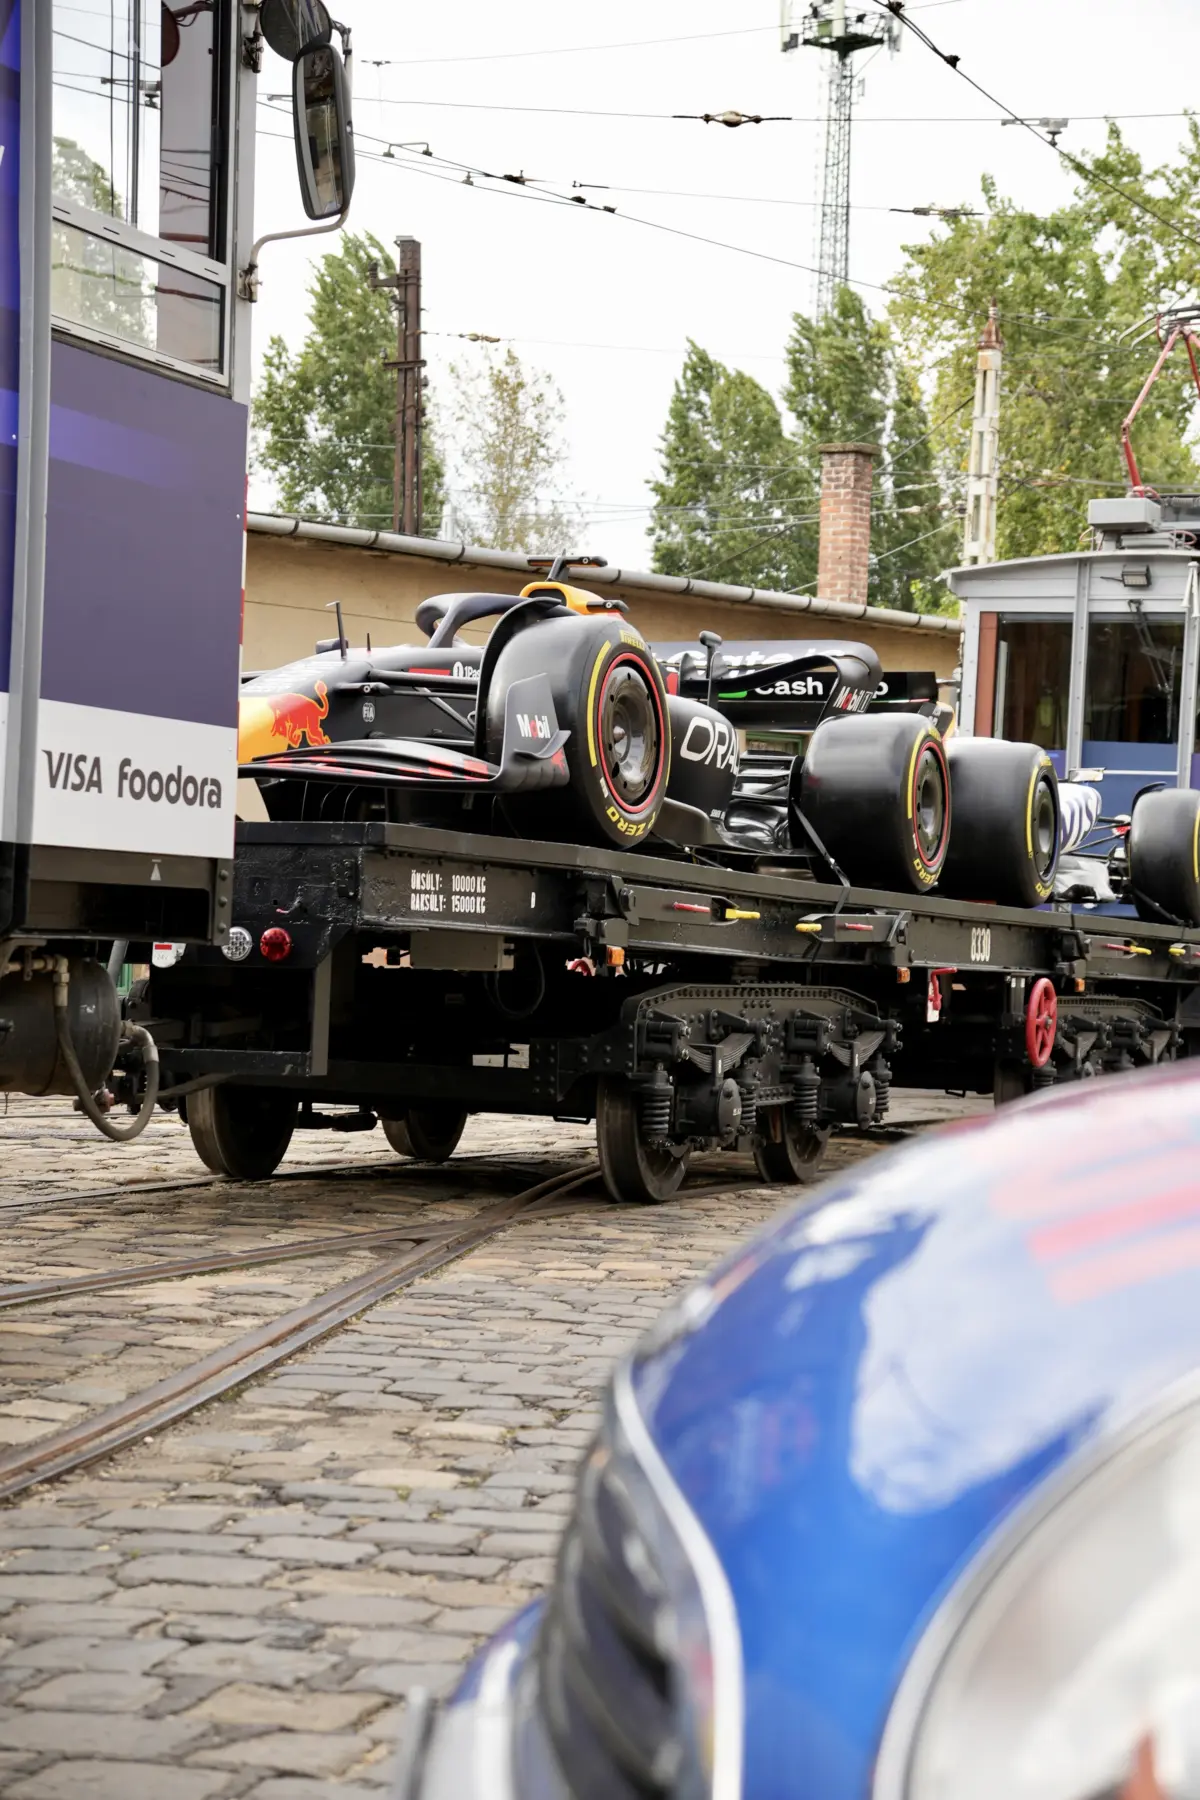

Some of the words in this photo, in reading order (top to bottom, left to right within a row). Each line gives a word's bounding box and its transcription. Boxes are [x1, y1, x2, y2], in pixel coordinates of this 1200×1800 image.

[516, 714, 551, 739] Mobil
[42, 749, 103, 794] VISA
[117, 757, 222, 809] foodora
[606, 806, 647, 836] ZERO
[451, 875, 476, 893] 10000
[476, 876, 486, 894] KG
[451, 894, 476, 913] 15000
[476, 896, 486, 914] KG
[970, 926, 991, 962] 8330
